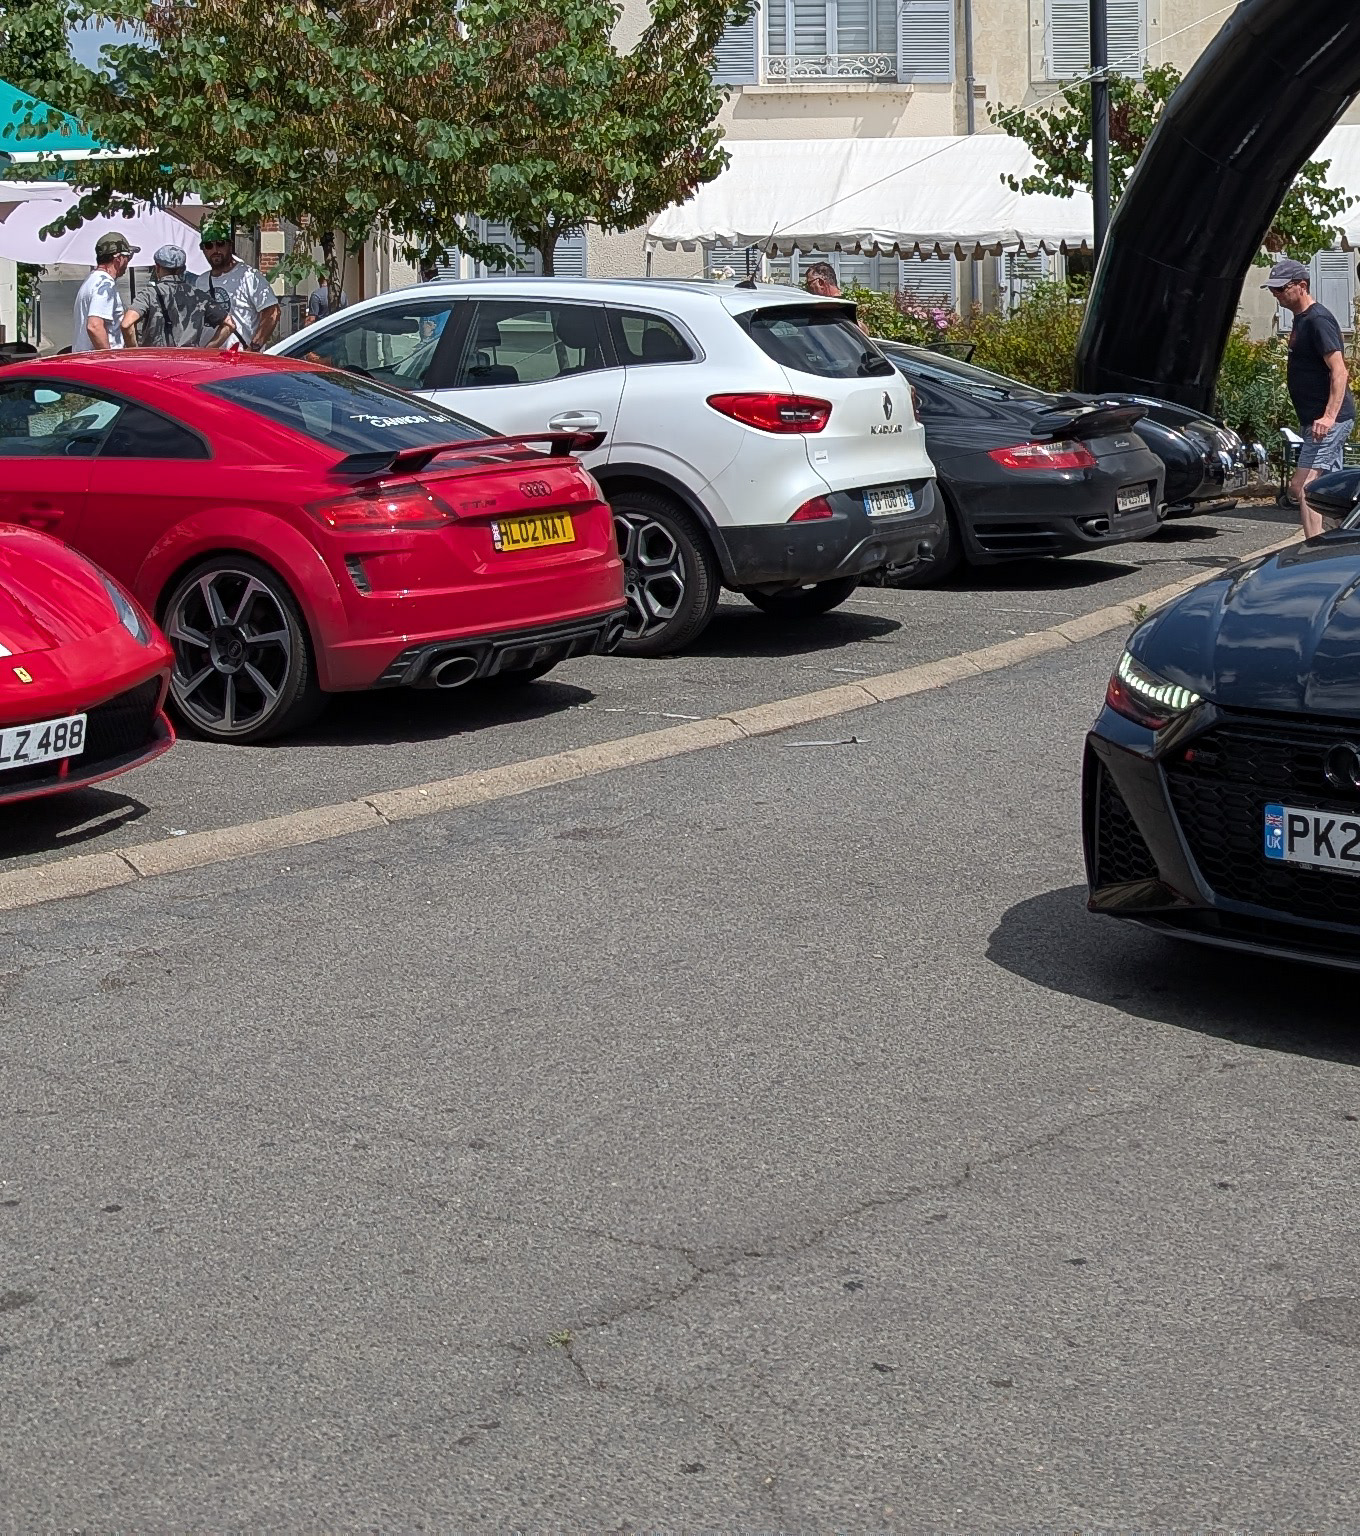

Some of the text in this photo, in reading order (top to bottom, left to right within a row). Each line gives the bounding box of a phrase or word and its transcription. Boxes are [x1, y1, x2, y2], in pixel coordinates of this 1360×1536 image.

[500, 515, 567, 546] HL02 NAT
[36, 719, 84, 755] 488
[1266, 834, 1282, 850] UK
